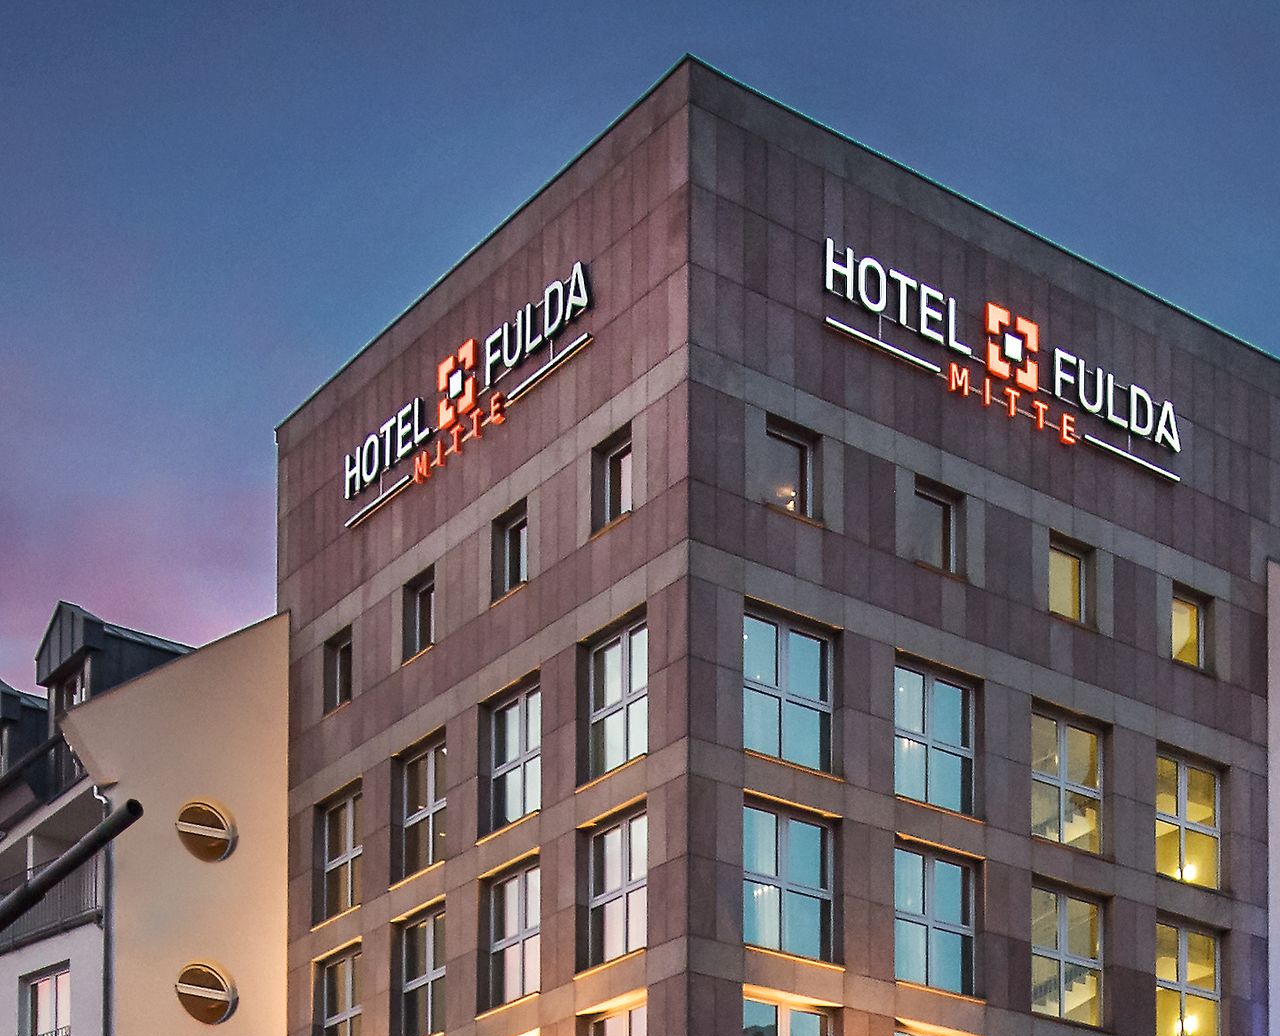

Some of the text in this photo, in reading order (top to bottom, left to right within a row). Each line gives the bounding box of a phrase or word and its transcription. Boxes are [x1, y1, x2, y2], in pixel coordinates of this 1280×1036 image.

[344, 261, 588, 499] HOTEL FULDA
[825, 237, 1181, 453] HOTEL FULDA
[948, 361, 1077, 445] MITTE
[414, 391, 506, 484] MITTE
